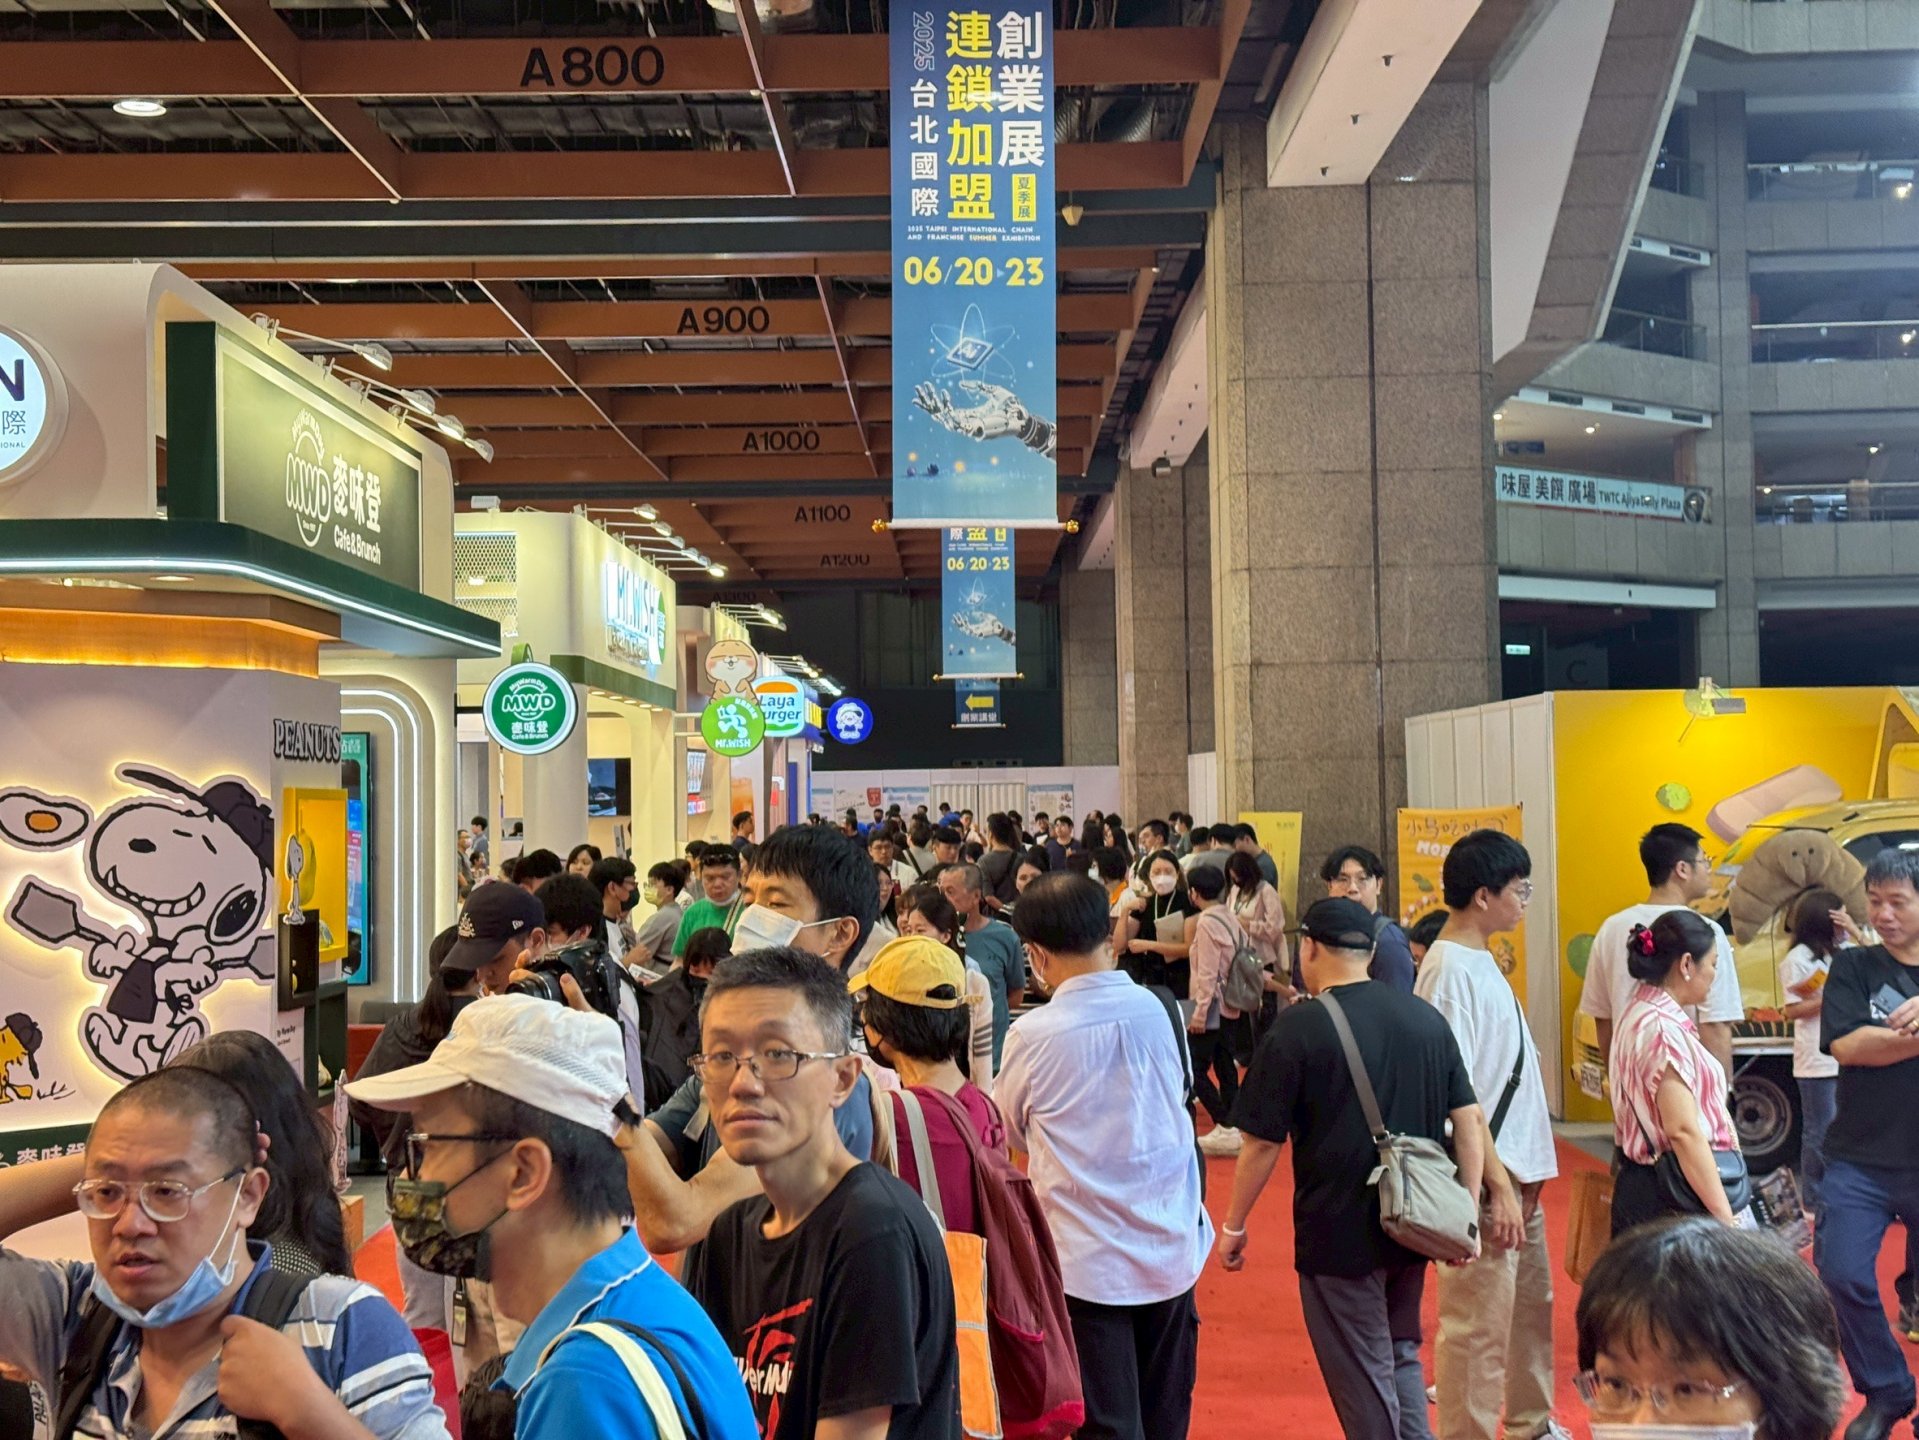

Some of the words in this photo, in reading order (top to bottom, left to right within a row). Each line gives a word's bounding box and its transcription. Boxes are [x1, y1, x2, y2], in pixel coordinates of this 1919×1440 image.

[913, 11, 935, 71] 2025
[520, 45, 665, 87] A800
[996, 10, 1045, 168] 創業展
[945, 10, 995, 220] 連鎖加盟
[909, 78, 940, 218] 台北國際
[1017, 176, 1031, 219] 夏季展
[904, 256, 993, 285] 06/20
[1005, 257, 1044, 286] 23
[677, 306, 770, 334] A900
[2, 410, 26, 435] 際
[742, 430, 821, 452] A1000
[286, 452, 331, 523] MWD
[333, 454, 381, 533] 麥味登
[1599, 490, 1620, 504] TWTC
[1661, 496, 1681, 510] Plaza
[794, 504, 851, 523] A1100
[501, 693, 556, 713] MWD
[759, 695, 790, 709] Laya
[765, 710, 802, 723] urger
[273, 718, 341, 763] PEANUTS
